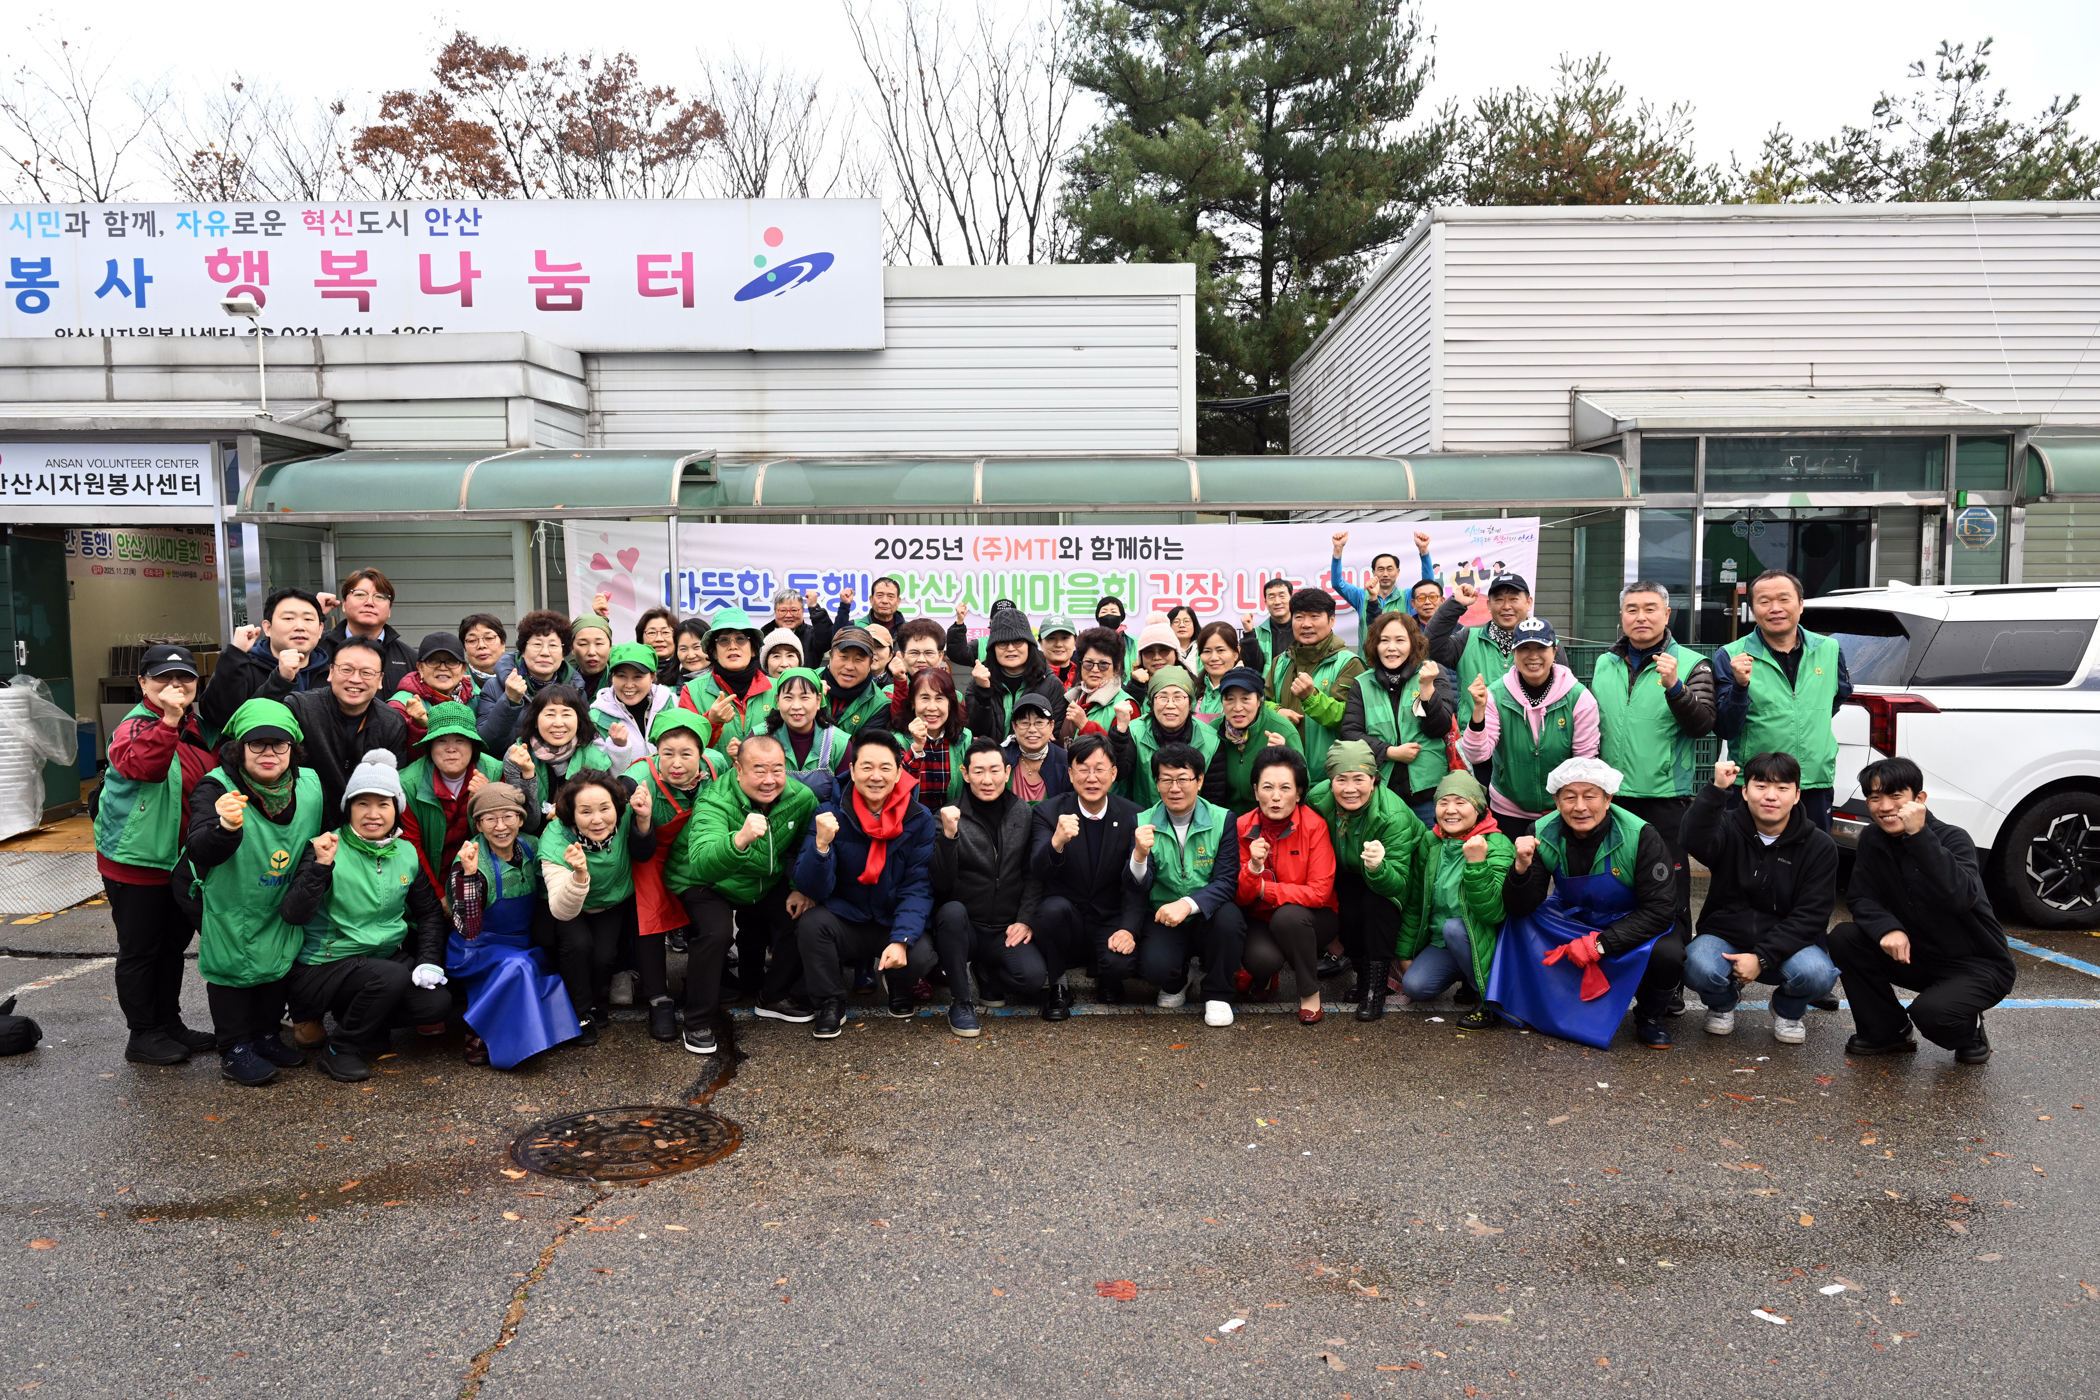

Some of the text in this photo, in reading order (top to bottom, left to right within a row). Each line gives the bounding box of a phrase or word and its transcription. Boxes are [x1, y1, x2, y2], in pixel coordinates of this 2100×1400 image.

[9, 207, 483, 239] 시민과 함께, 자유로운 혁신도시 안산
[45, 458, 199, 468] ANSAN VOLUNTEER CENTER
[80, 530, 112, 556] 동행!
[116, 533, 200, 563] 안산시새마을회
[874, 536, 1184, 562] 2025년 (주)MTI와 함께하는
[664, 569, 775, 612] 따뜻한
[1149, 572, 1224, 613] 김장
